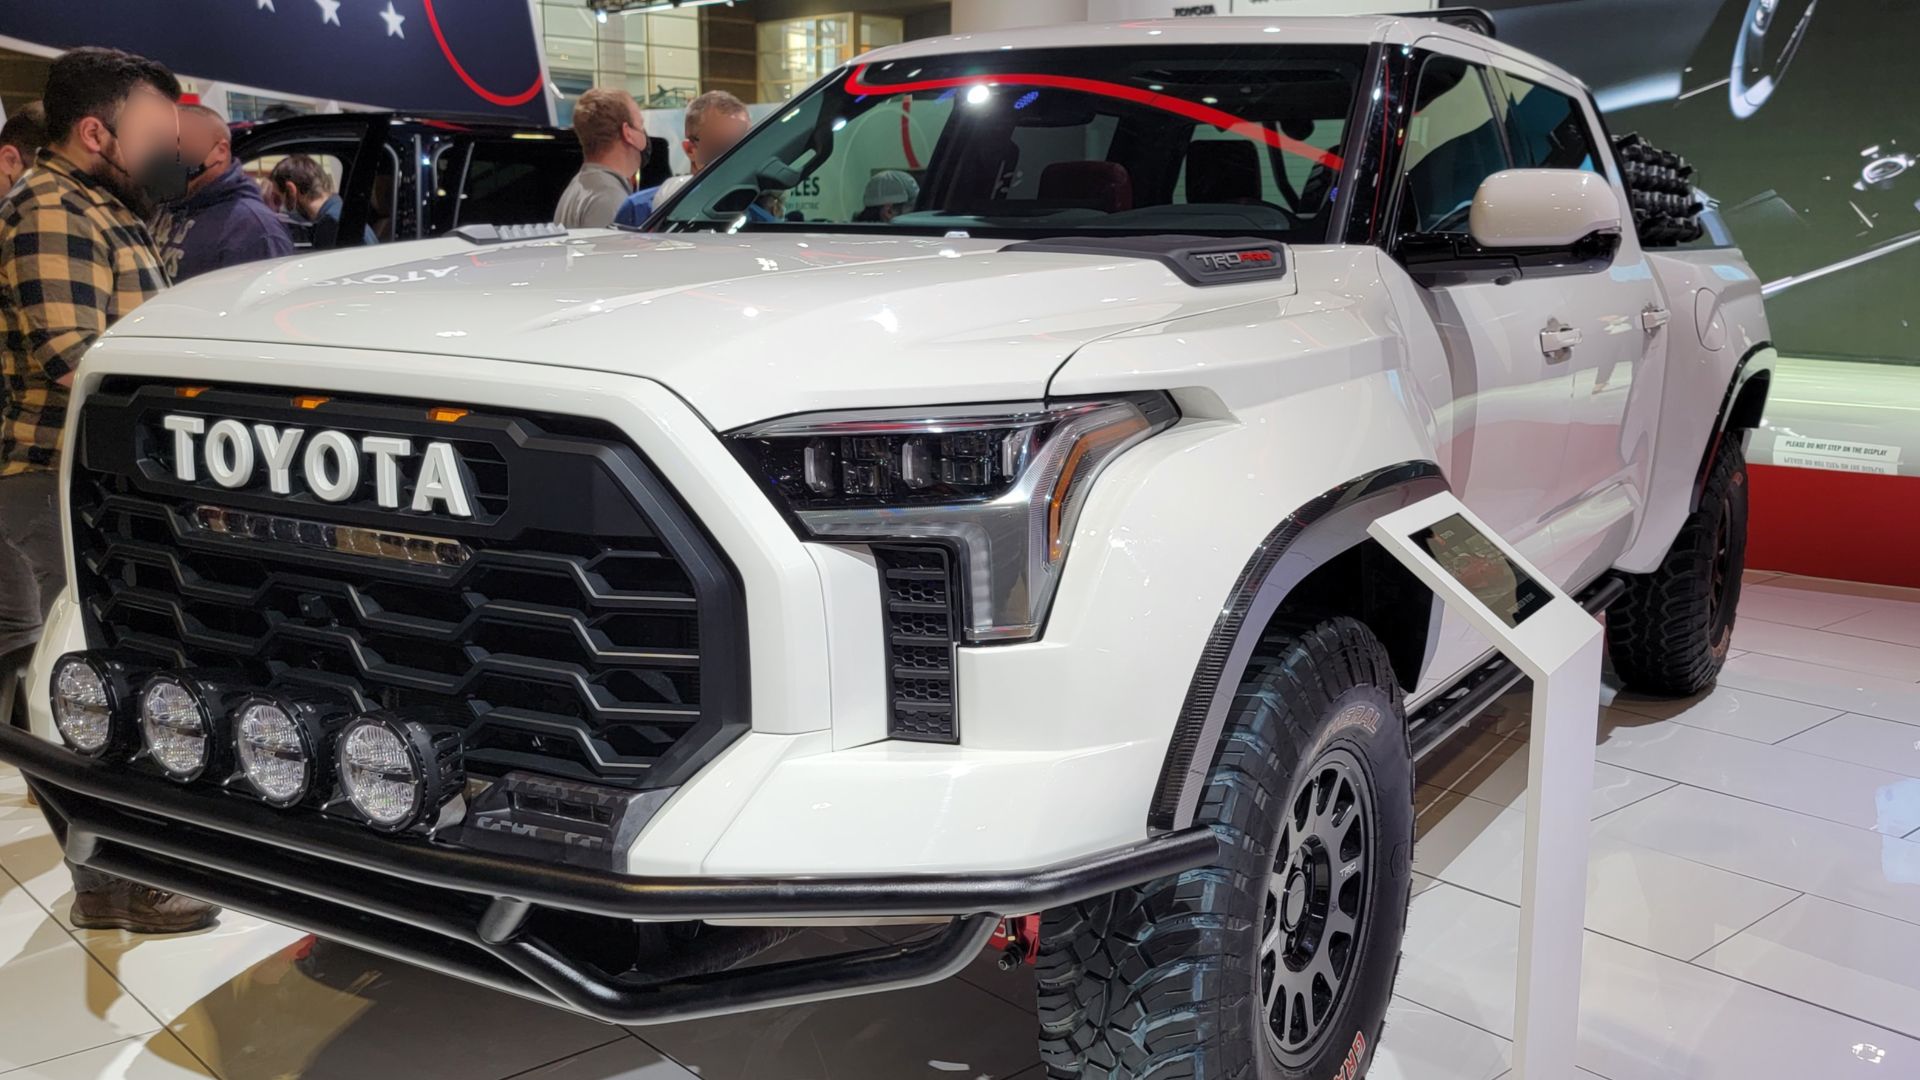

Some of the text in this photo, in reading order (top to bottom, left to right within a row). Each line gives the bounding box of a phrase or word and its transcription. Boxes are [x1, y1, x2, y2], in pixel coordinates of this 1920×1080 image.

[1173, 5, 1216, 17] TOYOTA
[790, 177, 820, 197] LES
[1785, 440, 1805, 449] PLEASE
[1816, 443, 1827, 451] NOT
[1827, 444, 1842, 452] STEP
[1863, 448, 1888, 456] DISPLAY
[164, 415, 472, 516] TOYOTA
